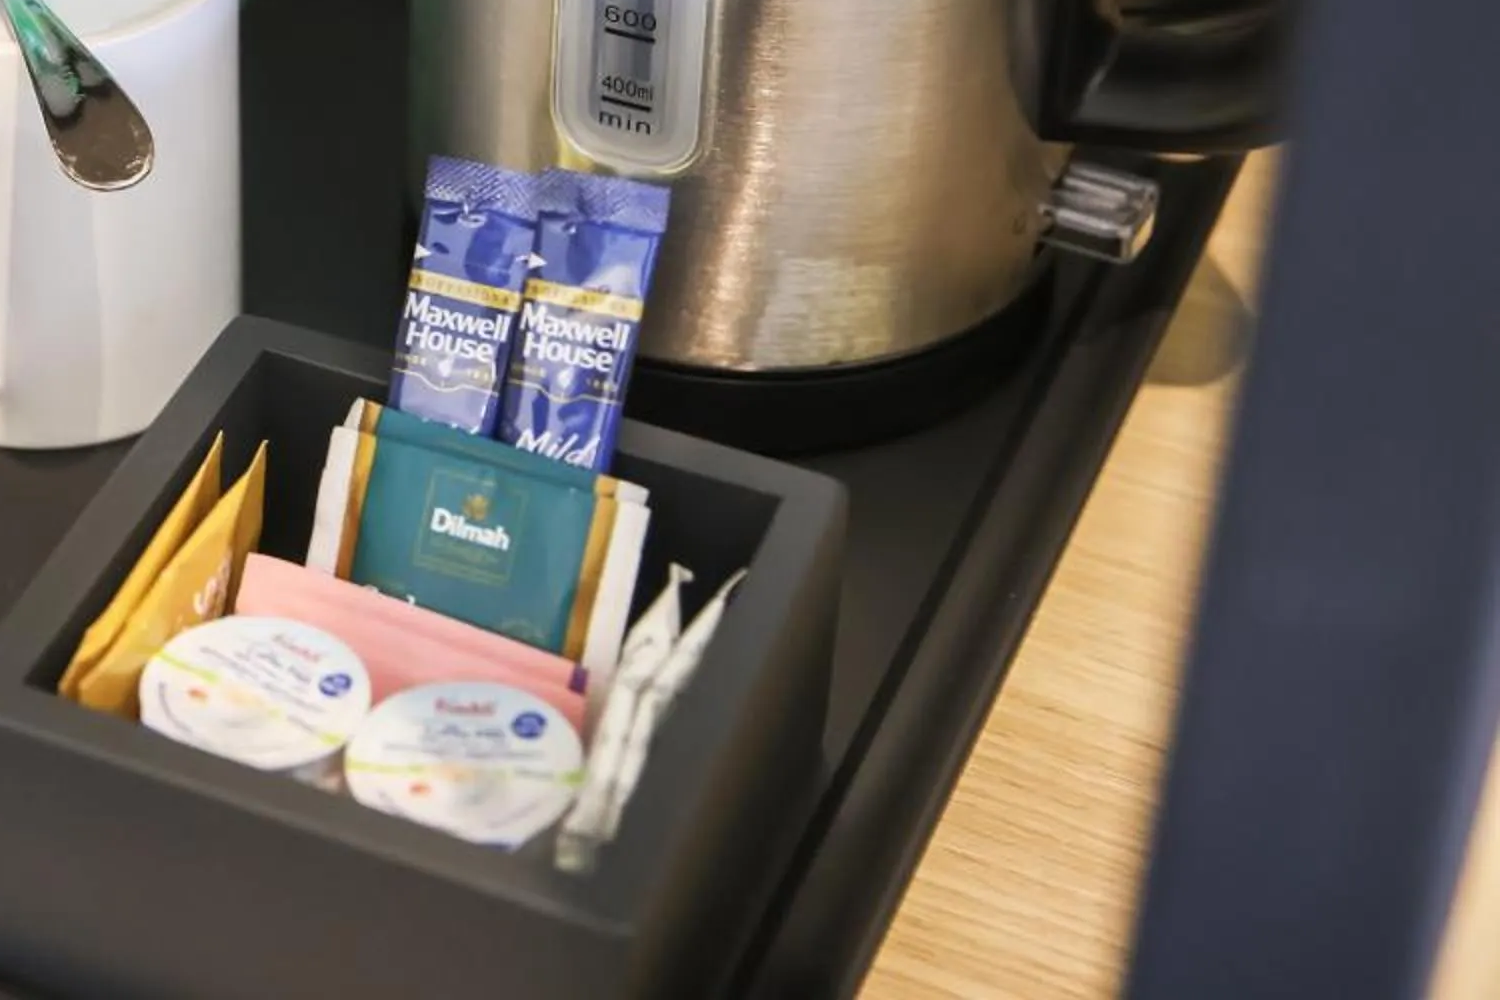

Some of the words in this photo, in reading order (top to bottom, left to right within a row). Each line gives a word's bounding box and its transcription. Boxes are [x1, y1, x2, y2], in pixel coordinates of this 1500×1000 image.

[604, 5, 657, 32] 600
[601, 75, 654, 102] 400ml
[599, 111, 652, 136] min
[404, 292, 511, 343] Maxwell
[520, 303, 630, 350] Maxwell
[405, 322, 493, 363] House
[523, 332, 613, 373] House
[515, 428, 602, 469] Mild
[430, 507, 511, 551] Dilmah
